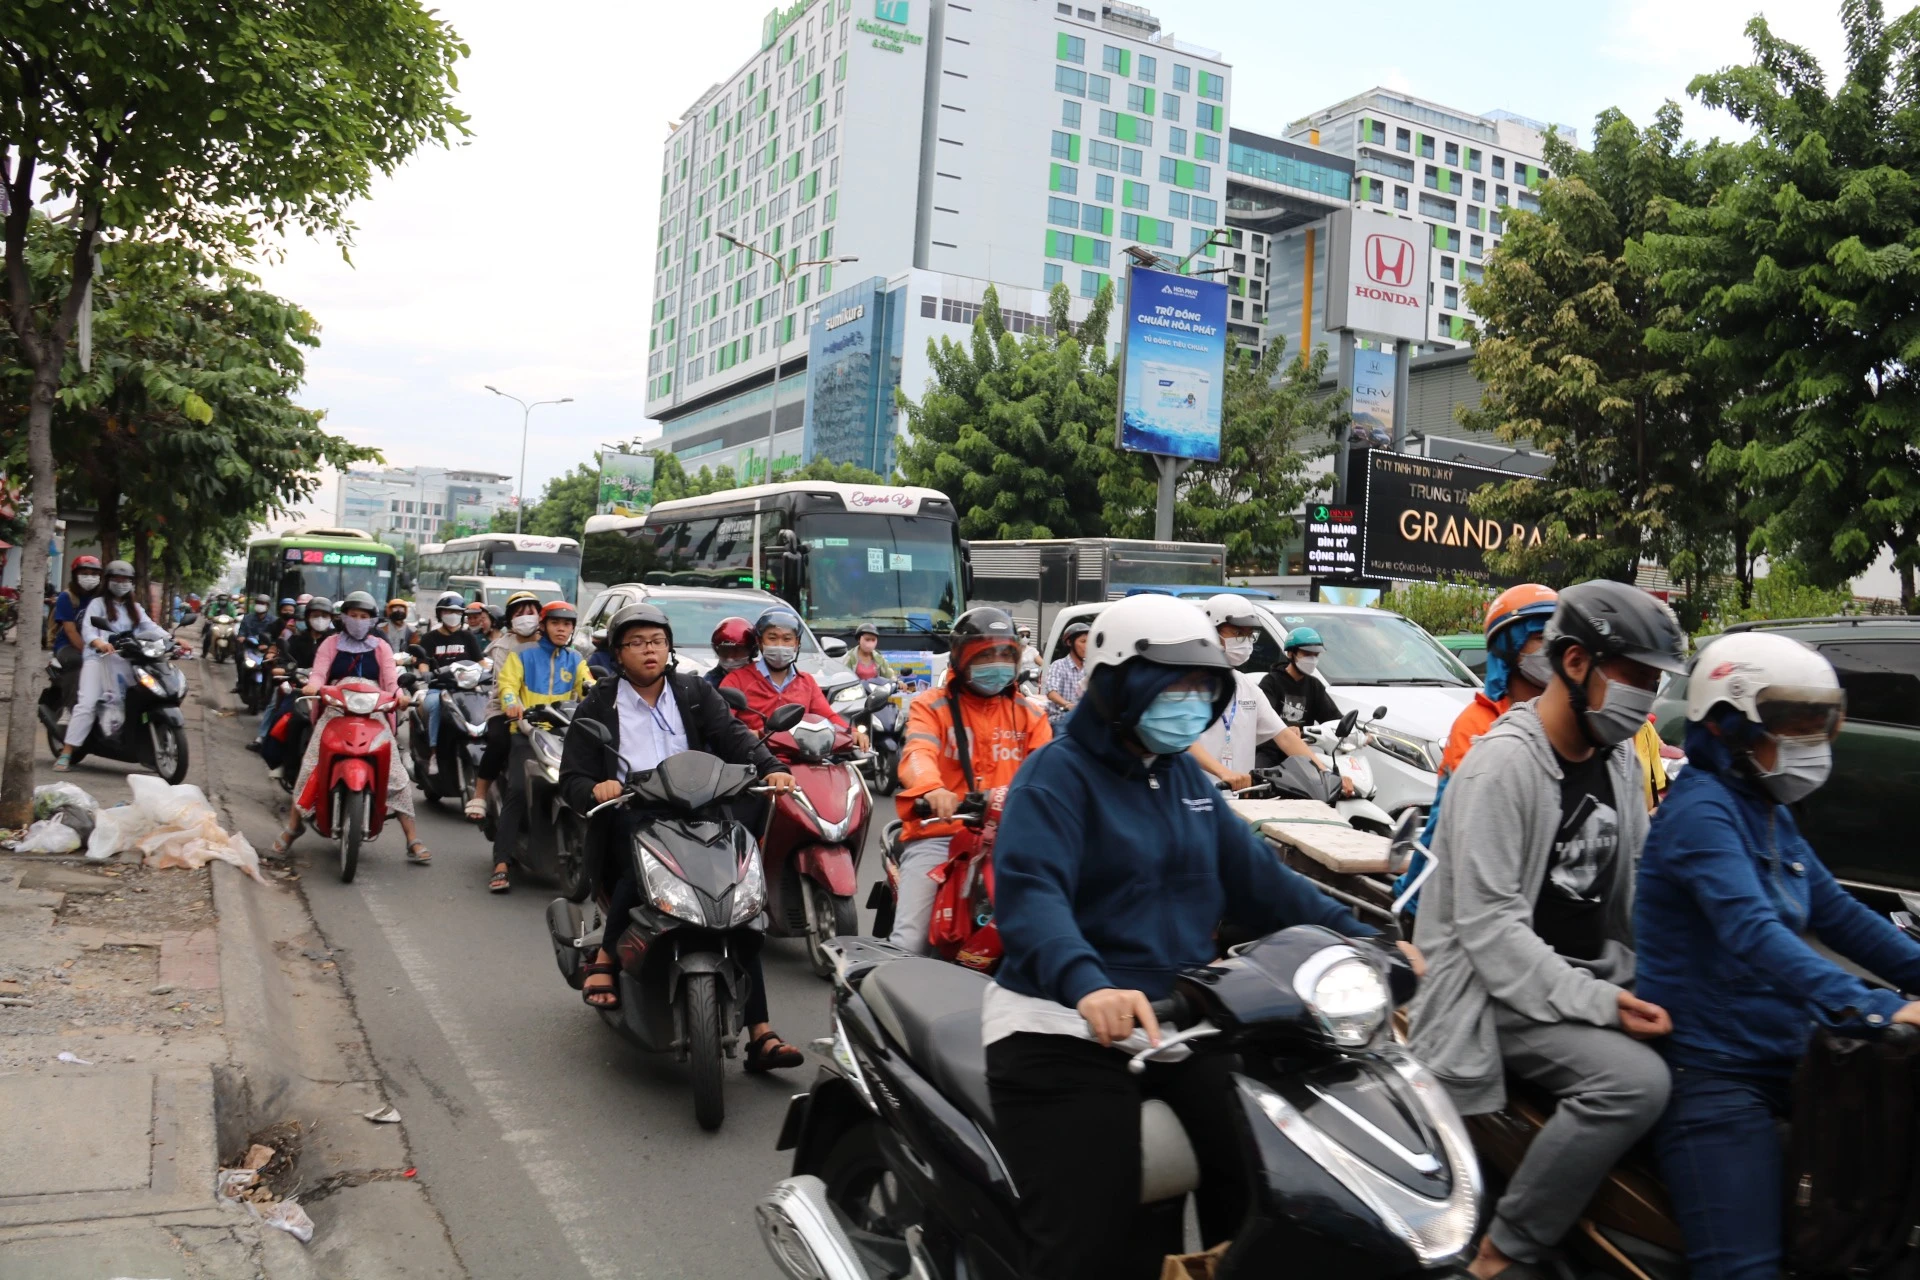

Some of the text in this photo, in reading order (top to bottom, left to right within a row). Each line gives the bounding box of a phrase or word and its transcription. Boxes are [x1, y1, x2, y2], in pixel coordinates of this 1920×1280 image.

[856, 18, 900, 43] Holiday
[1355, 286, 1420, 308] HONDA
[825, 304, 864, 332] sumikura
[1171, 319, 1190, 332] HÒA
[1192, 324, 1216, 336] PHÁT
[1356, 386, 1391, 398] CR-V
[1409, 483, 1452, 502] TRUNG
[1310, 522, 1357, 535] NHÀ HÀNG
[1400, 509, 1503, 550] GRAND
[1317, 536, 1334, 547] DÌN
[1309, 550, 1356, 562] CỘNG HÒA
